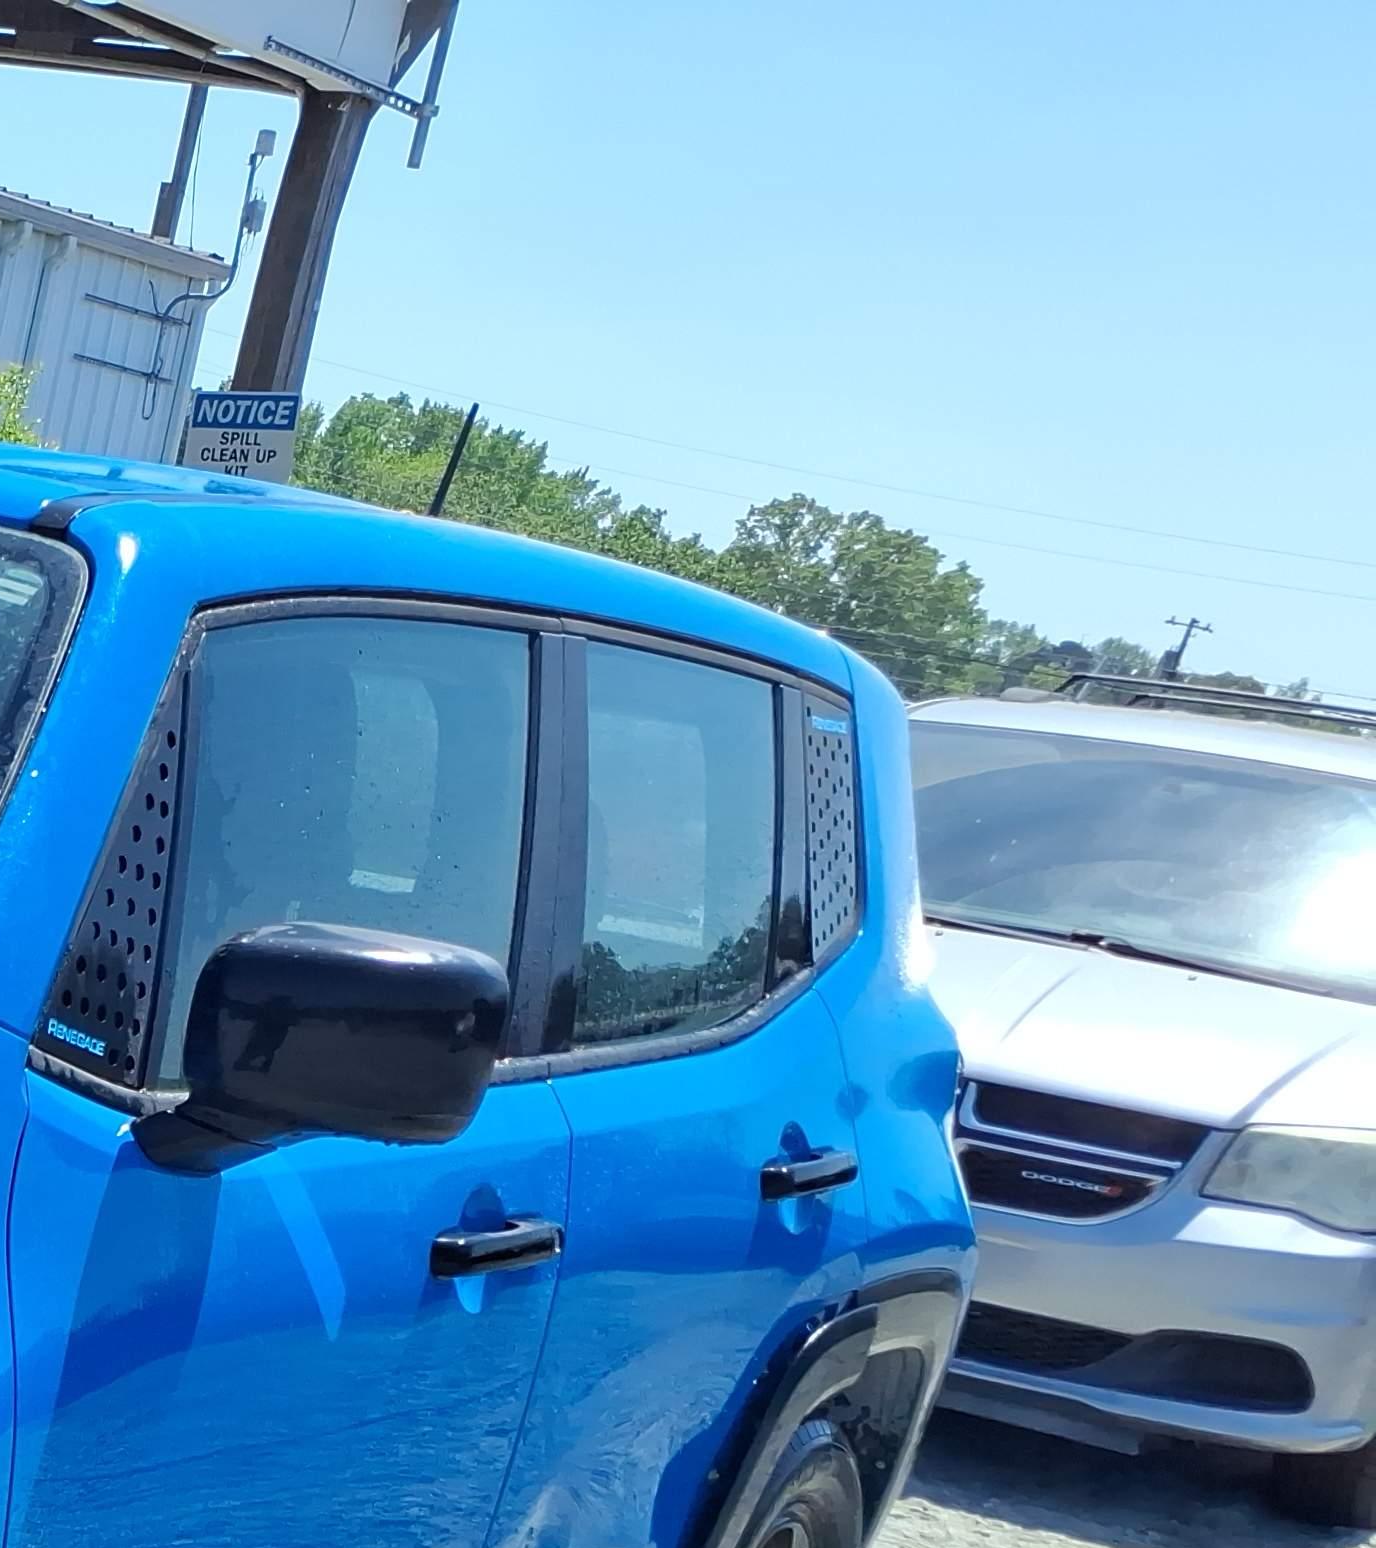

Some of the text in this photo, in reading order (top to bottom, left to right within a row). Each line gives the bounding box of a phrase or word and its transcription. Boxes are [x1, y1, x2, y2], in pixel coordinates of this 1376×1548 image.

[197, 399, 295, 426] NOTICE
[219, 431, 261, 446] SPILL
[201, 447, 277, 463] CLEAN UP
[47, 1018, 106, 1057] RENEGADE
[1021, 1170, 1110, 1195] DODGE
